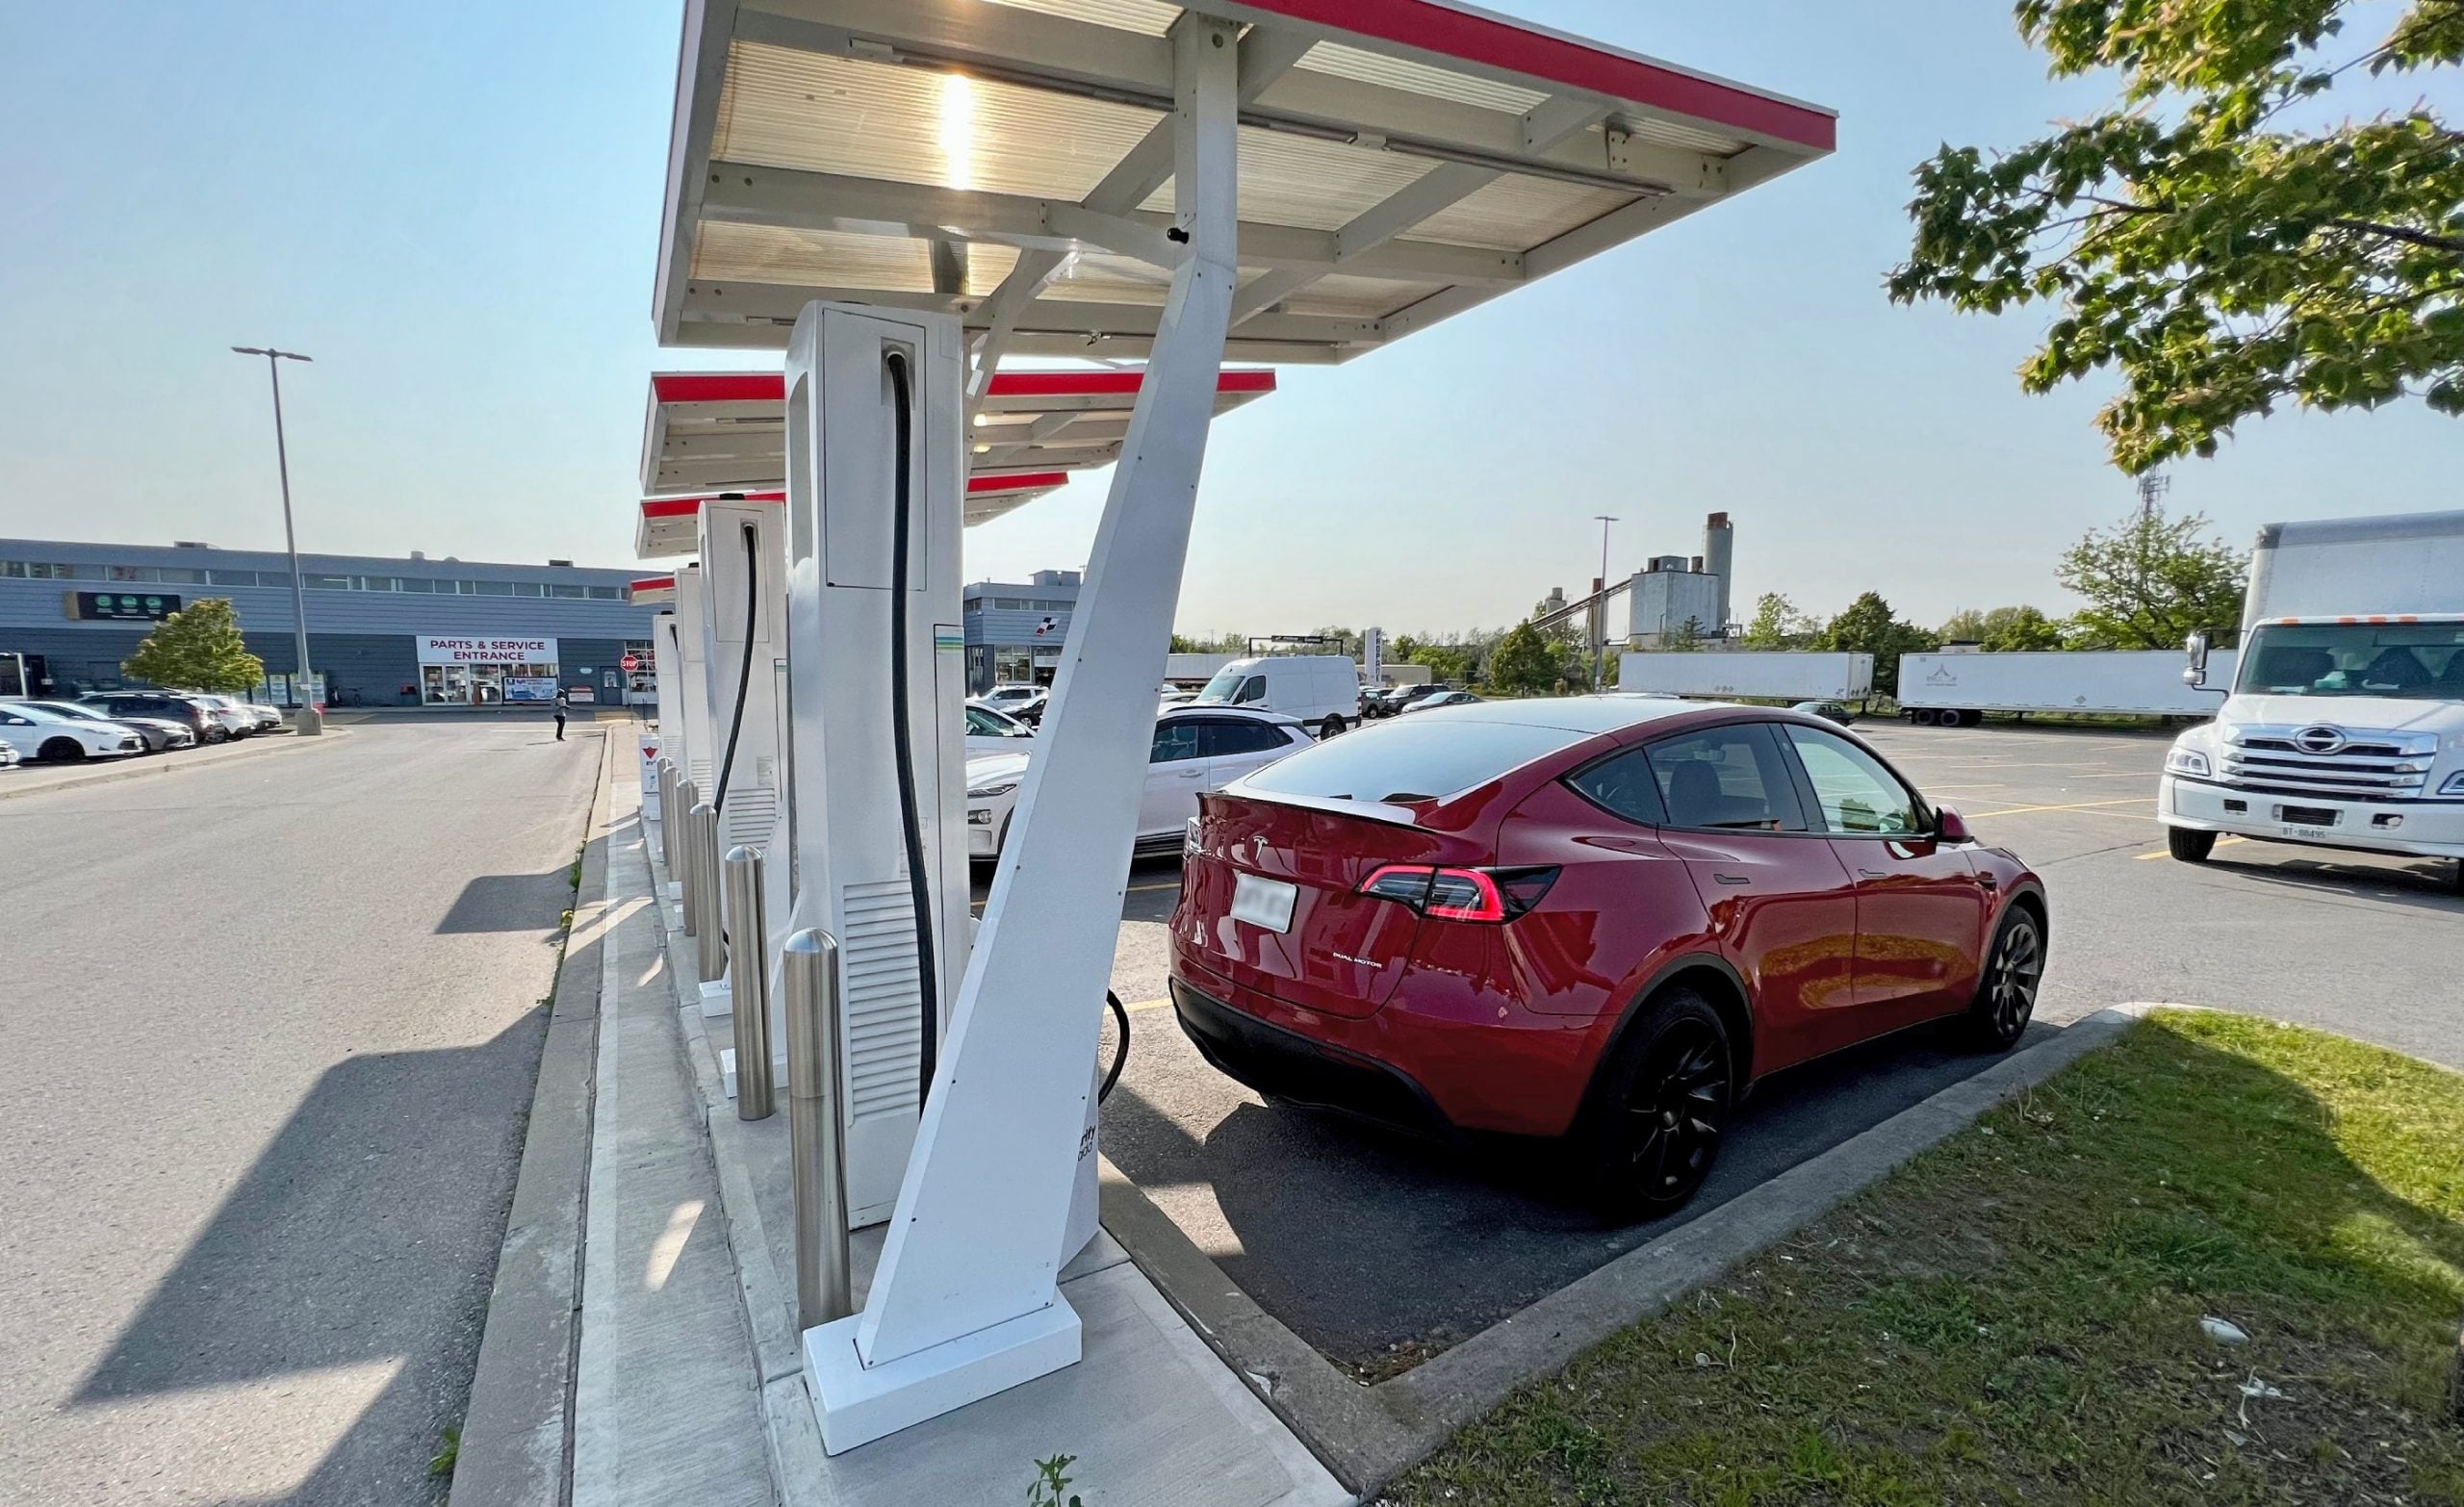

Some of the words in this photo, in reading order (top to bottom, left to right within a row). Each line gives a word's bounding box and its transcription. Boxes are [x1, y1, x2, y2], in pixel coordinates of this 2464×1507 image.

[430, 640, 473, 650] PARTS
[477, 641, 486, 650] &
[491, 641, 546, 651] SERVICE
[453, 651, 526, 661] ENTRANCE
[1332, 952, 1353, 962] DUAL
[1353, 958, 1383, 969] MOTOR
